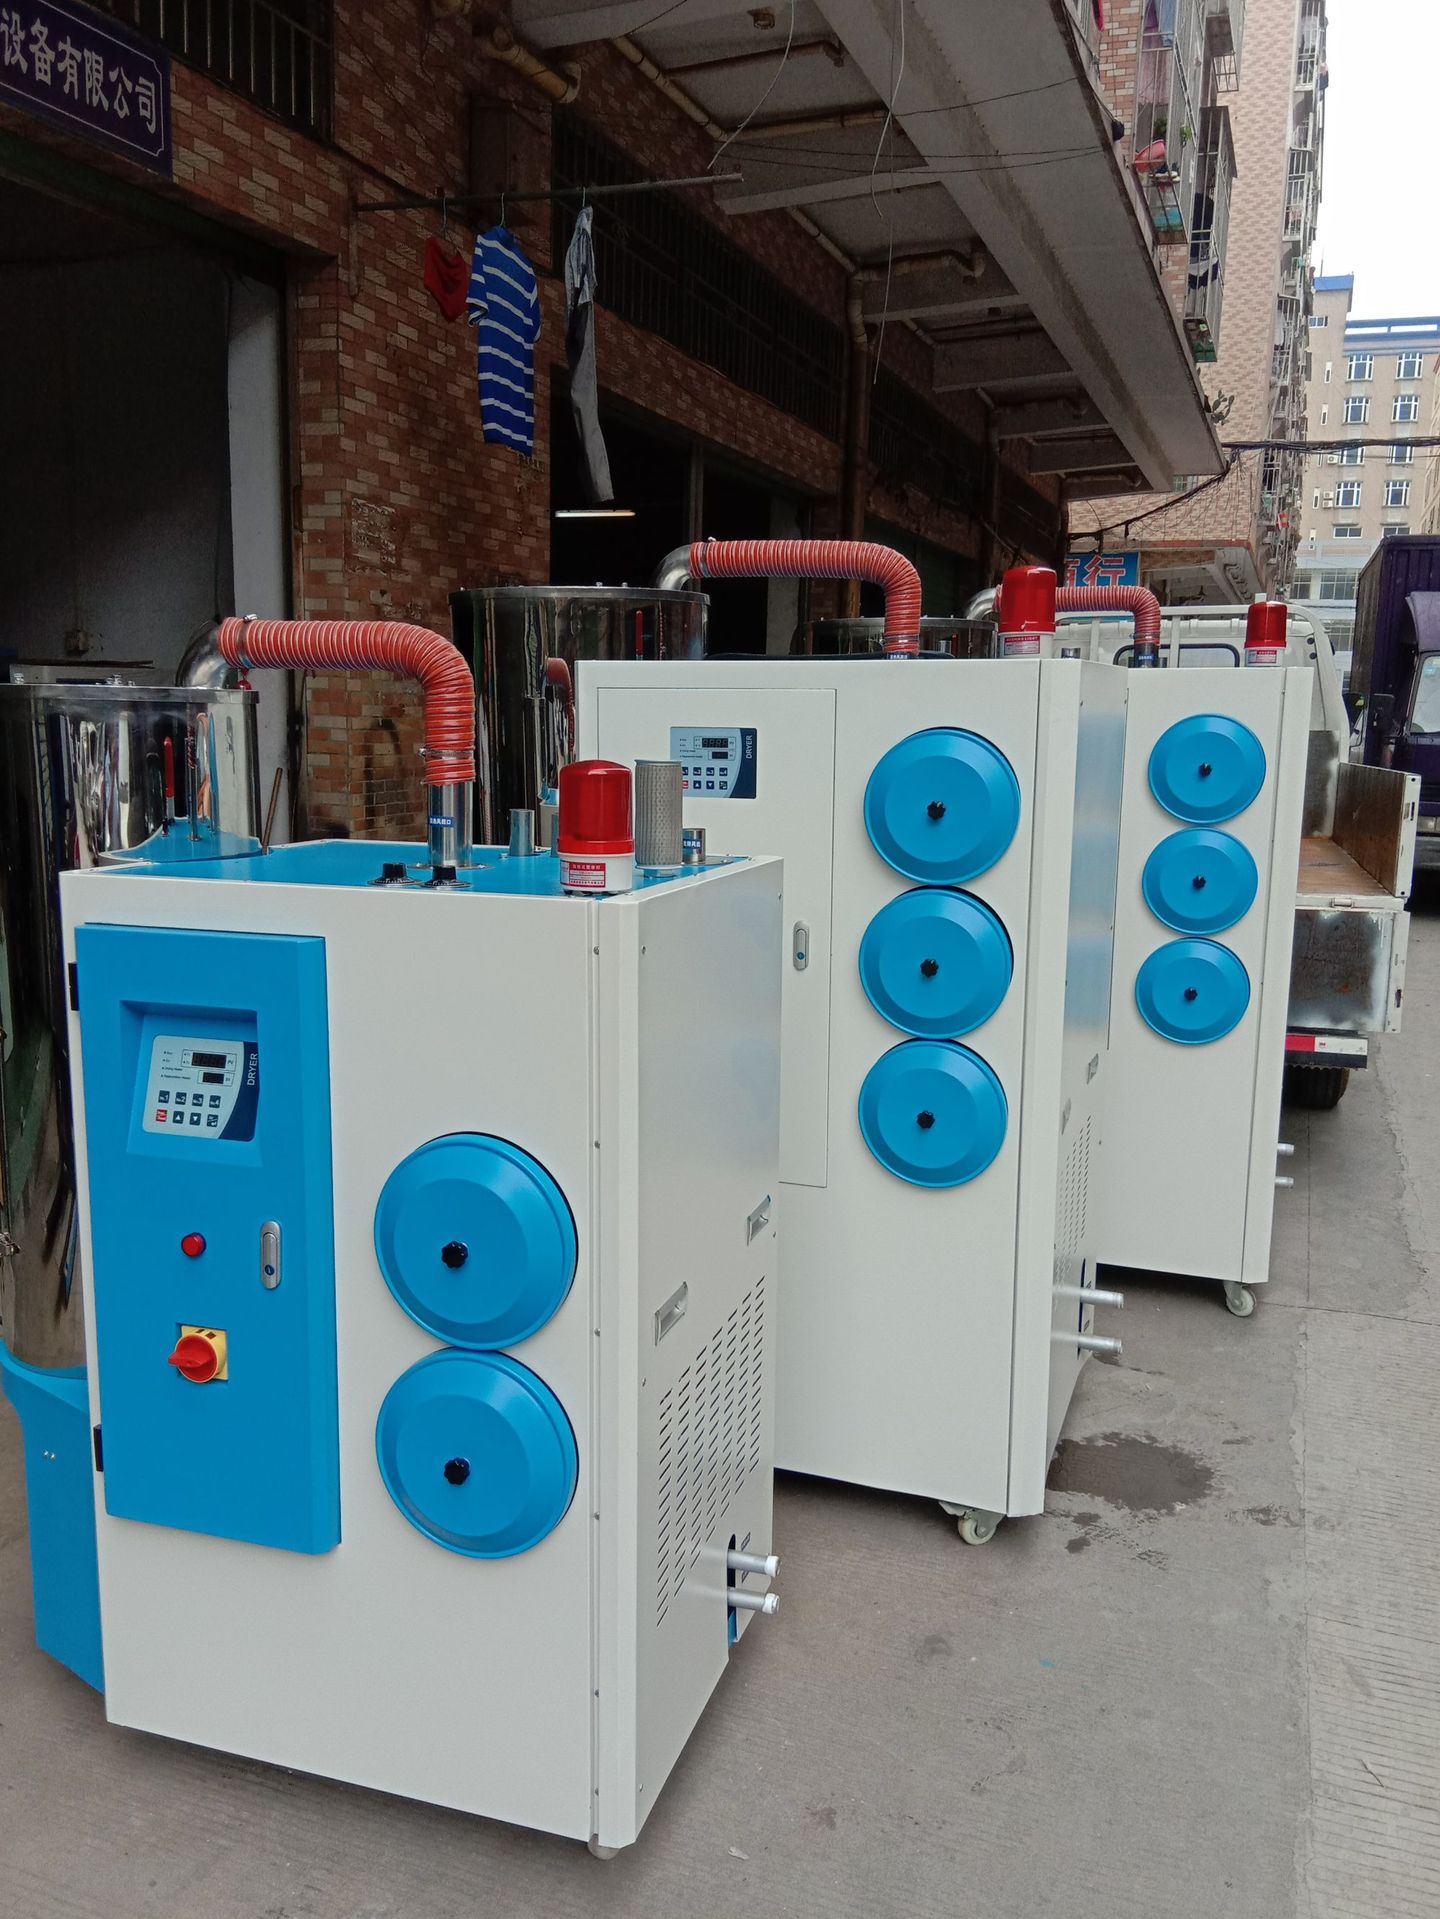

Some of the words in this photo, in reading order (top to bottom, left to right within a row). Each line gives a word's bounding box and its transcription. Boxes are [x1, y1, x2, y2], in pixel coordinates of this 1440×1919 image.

[0, 8, 156, 134] 设备有限公司
[745, 735, 753, 759] DRYER
[247, 1053, 258, 1086] DRYER
